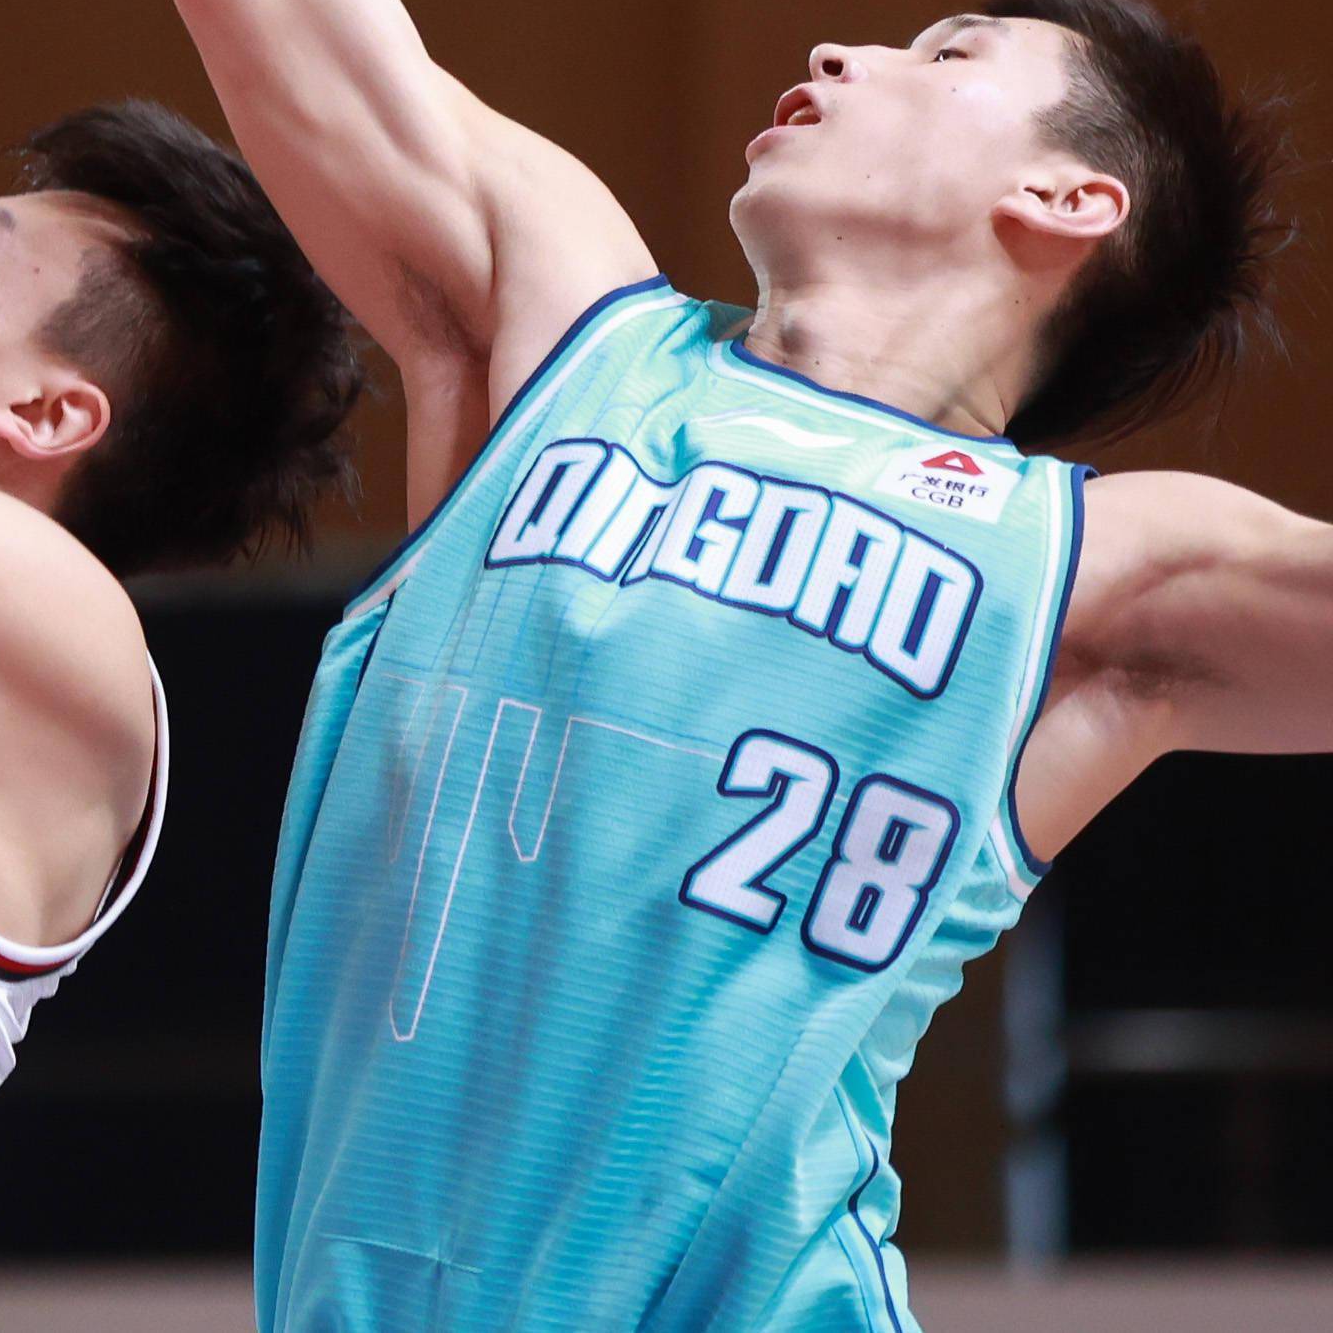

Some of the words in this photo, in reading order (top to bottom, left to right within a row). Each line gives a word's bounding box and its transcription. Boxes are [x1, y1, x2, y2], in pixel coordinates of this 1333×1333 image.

[898, 473, 989, 498] 广发银行
[911, 486, 964, 509] CGB
[484, 438, 984, 700] QINGDAO
[679, 728, 961, 973] 28
